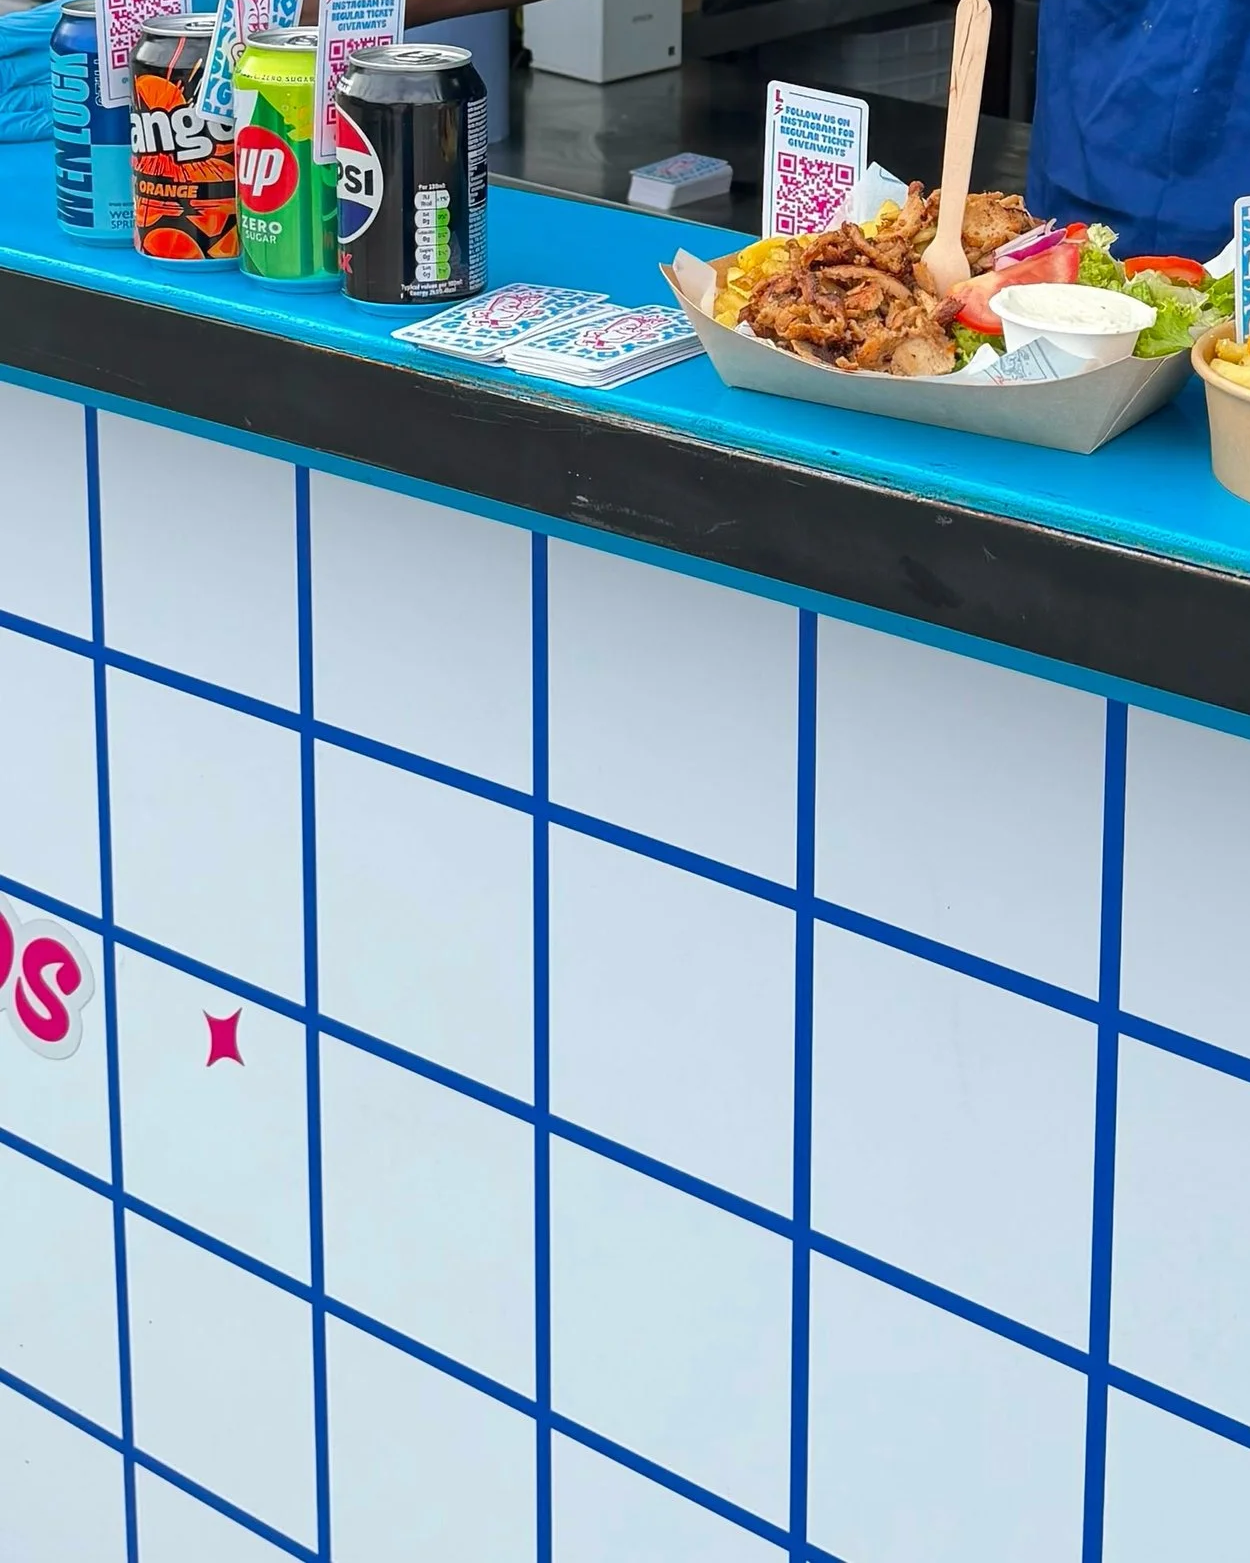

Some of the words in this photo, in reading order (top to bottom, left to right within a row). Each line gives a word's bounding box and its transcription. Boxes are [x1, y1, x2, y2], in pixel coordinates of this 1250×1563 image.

[331, 10, 365, 21] REGULAR
[366, 9, 394, 18] TICKET
[338, 19, 387, 31] GIVEAWAYS
[785, 106, 822, 121] FOLLOW
[824, 114, 836, 124] US
[837, 118, 850, 127] ON
[780, 115, 836, 135] INSTAGRAM
[838, 127, 854, 138] FOR
[780, 125, 820, 141] REGULAR
[821, 134, 854, 148] TICKET
[788, 138, 846, 157] GIVEAWAYS
[140, 181, 198, 198] ORANGE
[242, 215, 283, 235] ZERO
[245, 230, 277, 244] SUGAR
